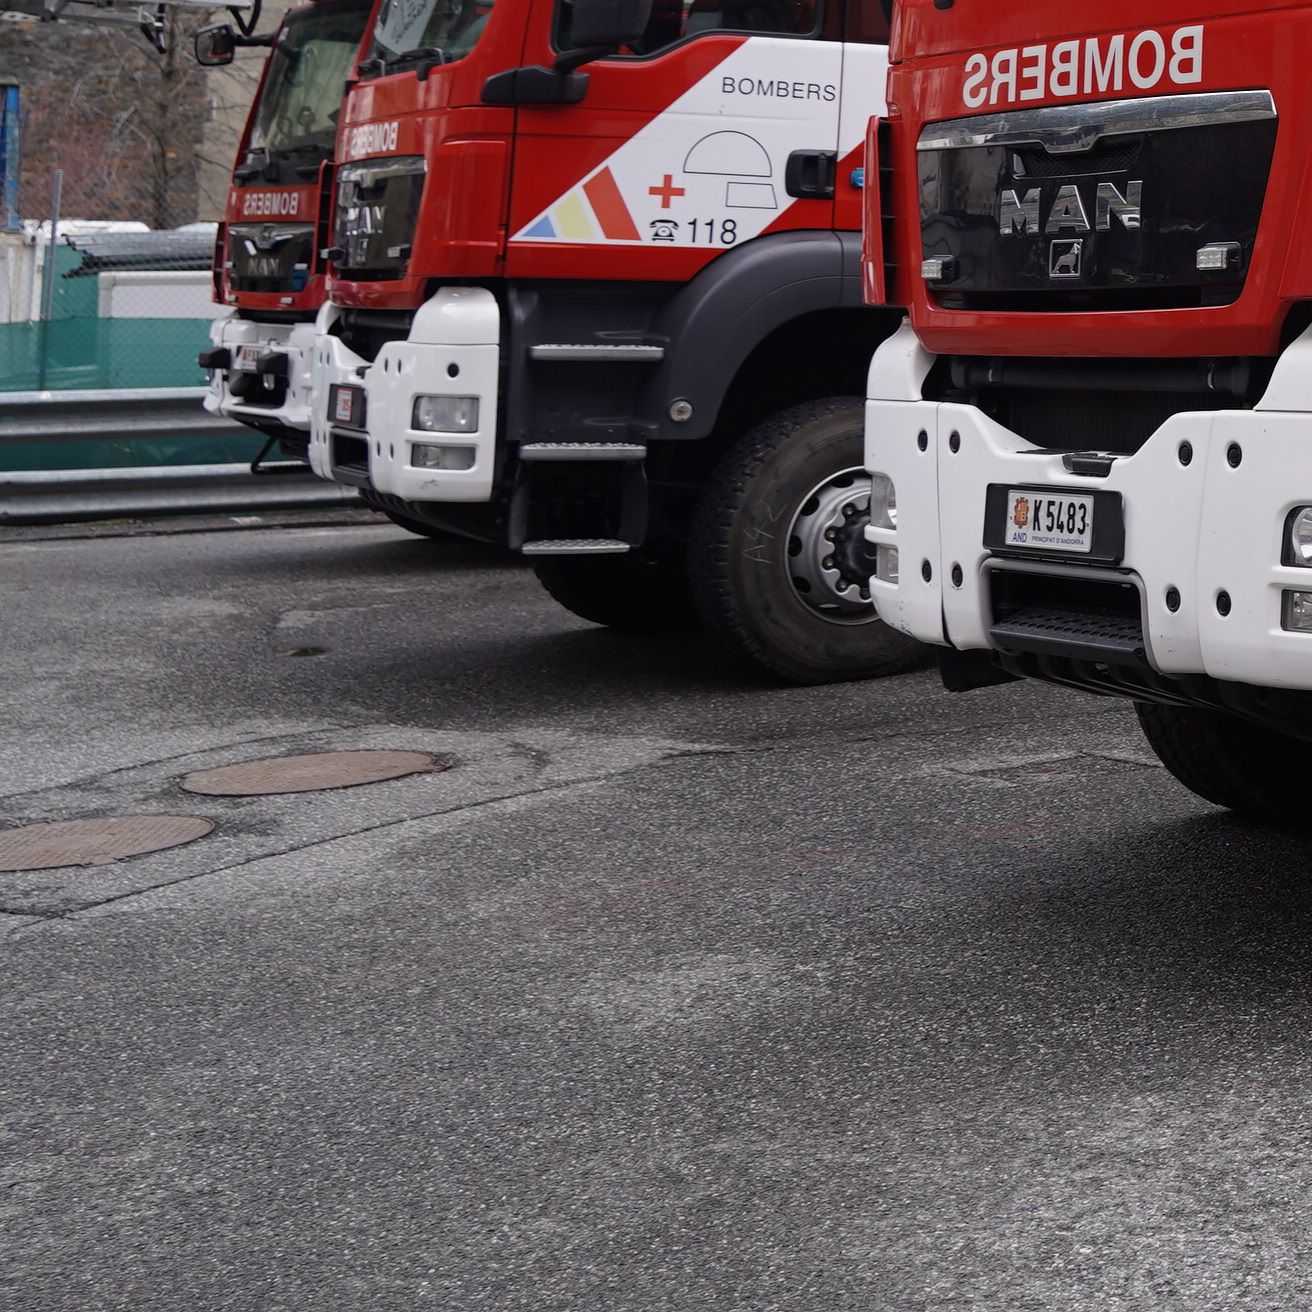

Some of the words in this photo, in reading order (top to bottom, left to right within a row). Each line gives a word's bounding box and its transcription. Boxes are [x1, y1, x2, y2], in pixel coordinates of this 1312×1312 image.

[722, 76, 836, 102] BOMBERS
[1000, 181, 1143, 235] MAN
[688, 218, 737, 245] 118
[1033, 499, 1042, 531] K
[1046, 500, 1087, 535] 5483
[1012, 532, 1027, 543] AND
